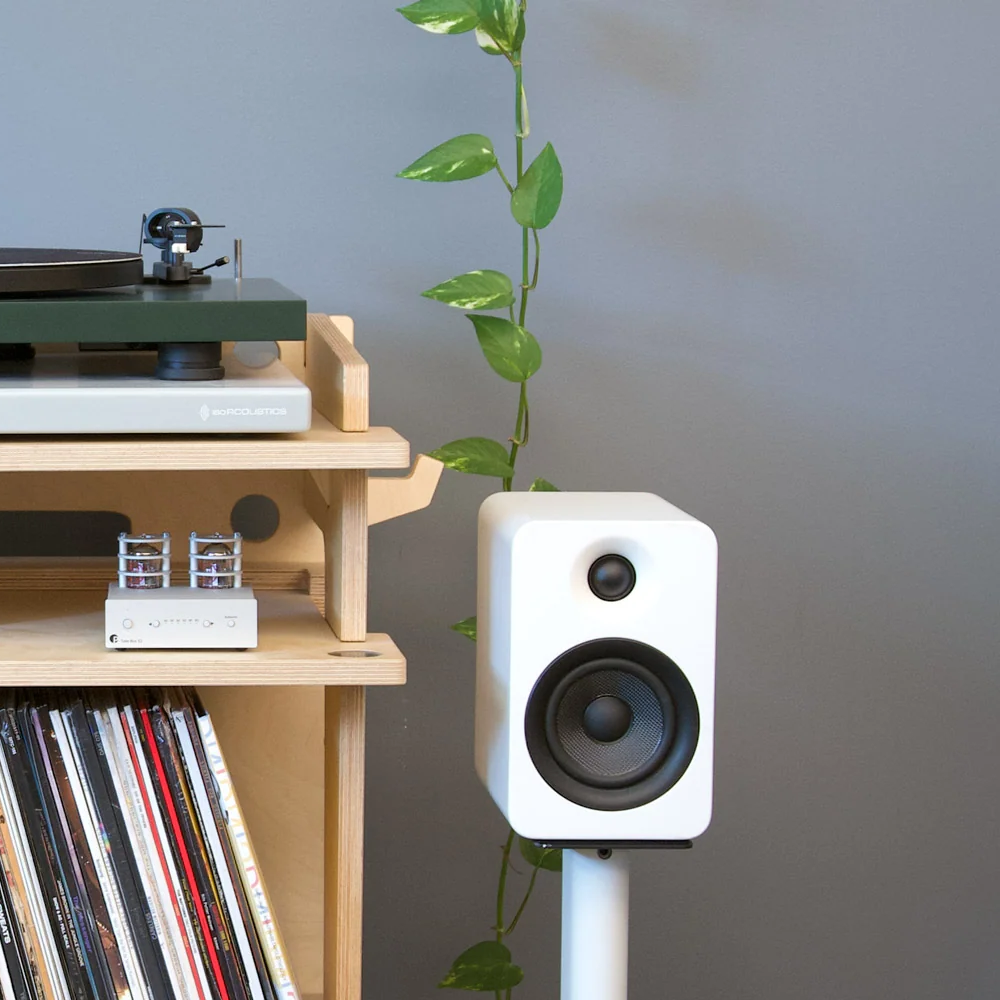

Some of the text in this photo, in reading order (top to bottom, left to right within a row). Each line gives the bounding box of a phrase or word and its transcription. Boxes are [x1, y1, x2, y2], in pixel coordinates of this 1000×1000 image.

[55, 878, 64, 896] JAMES
[60, 895, 70, 914] BROWN
[69, 927, 79, 947] JUNGLE
[75, 946, 85, 967] GROOVE
[59, 922, 67, 934] FULL
[62, 932, 71, 949] SCALE
